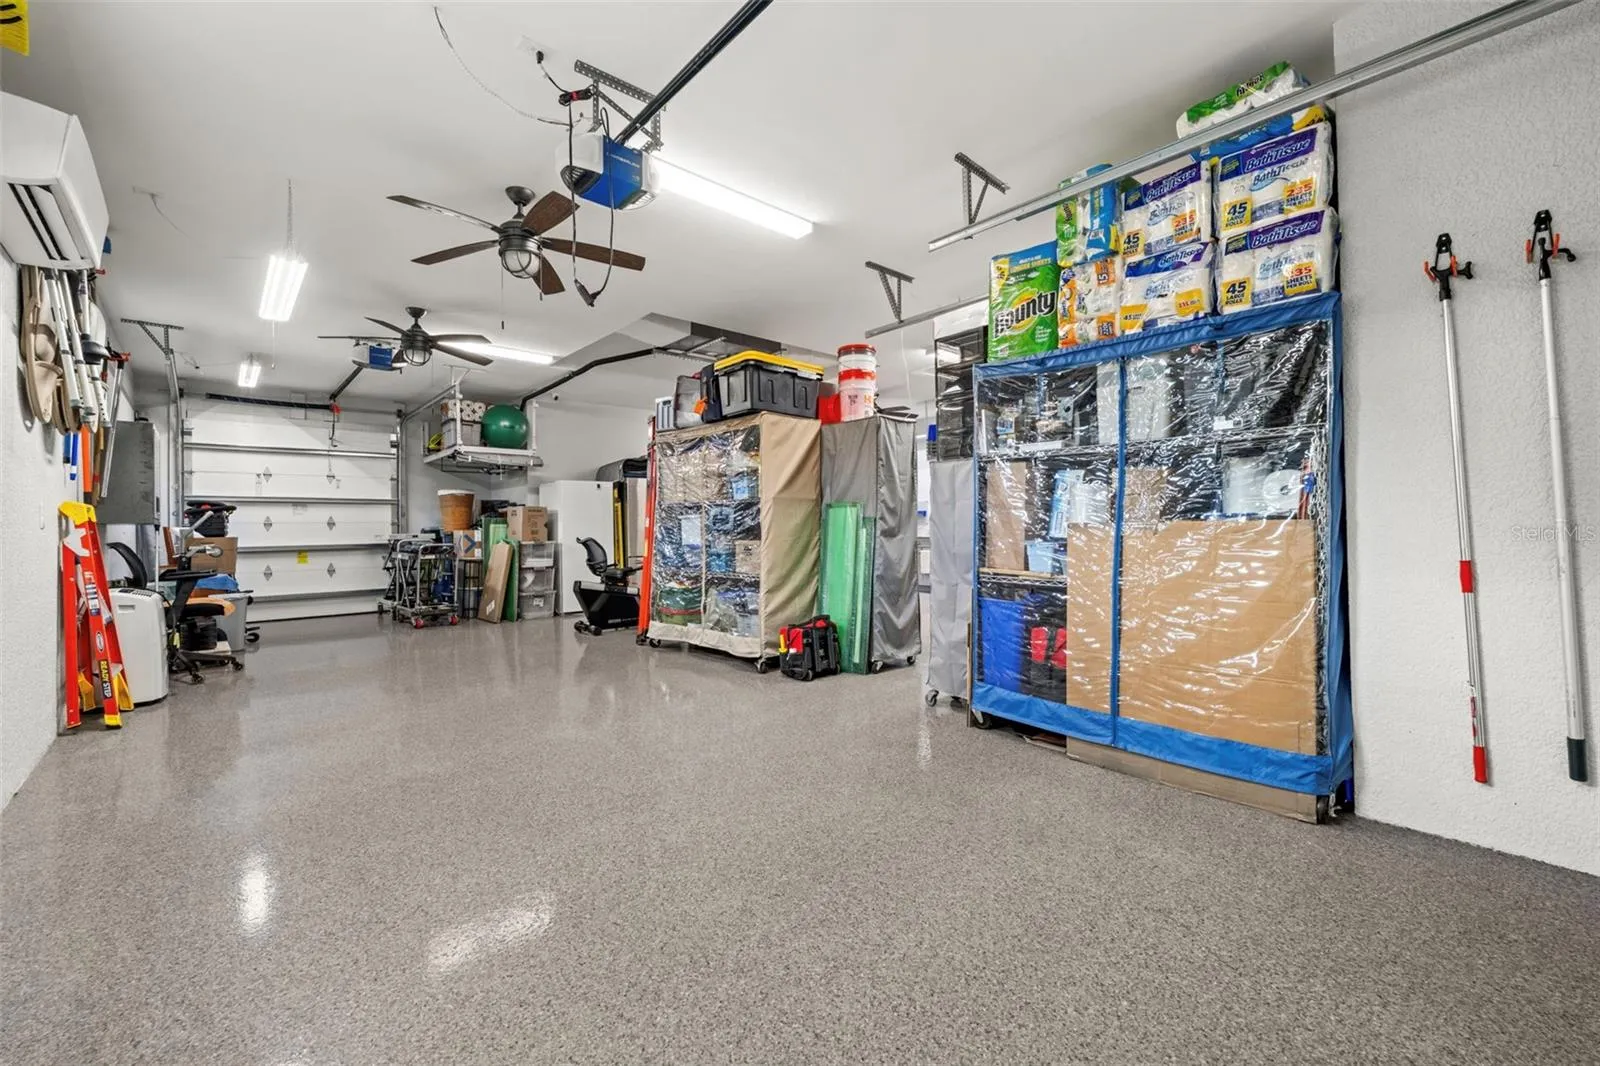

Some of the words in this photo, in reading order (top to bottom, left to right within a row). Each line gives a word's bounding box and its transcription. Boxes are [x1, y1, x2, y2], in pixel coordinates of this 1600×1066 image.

[1286, 183, 1313, 197] 235
[1227, 201, 1248, 216] 45
[1124, 232, 1140, 245] 45
[1286, 274, 1313, 285] SHEETS
[1226, 281, 1247, 295] 45
[1226, 292, 1245, 300] LARGE
[994, 291, 1057, 339] Bounty
[101, 661, 109, 682] READY
[103, 683, 112, 698] STEP
